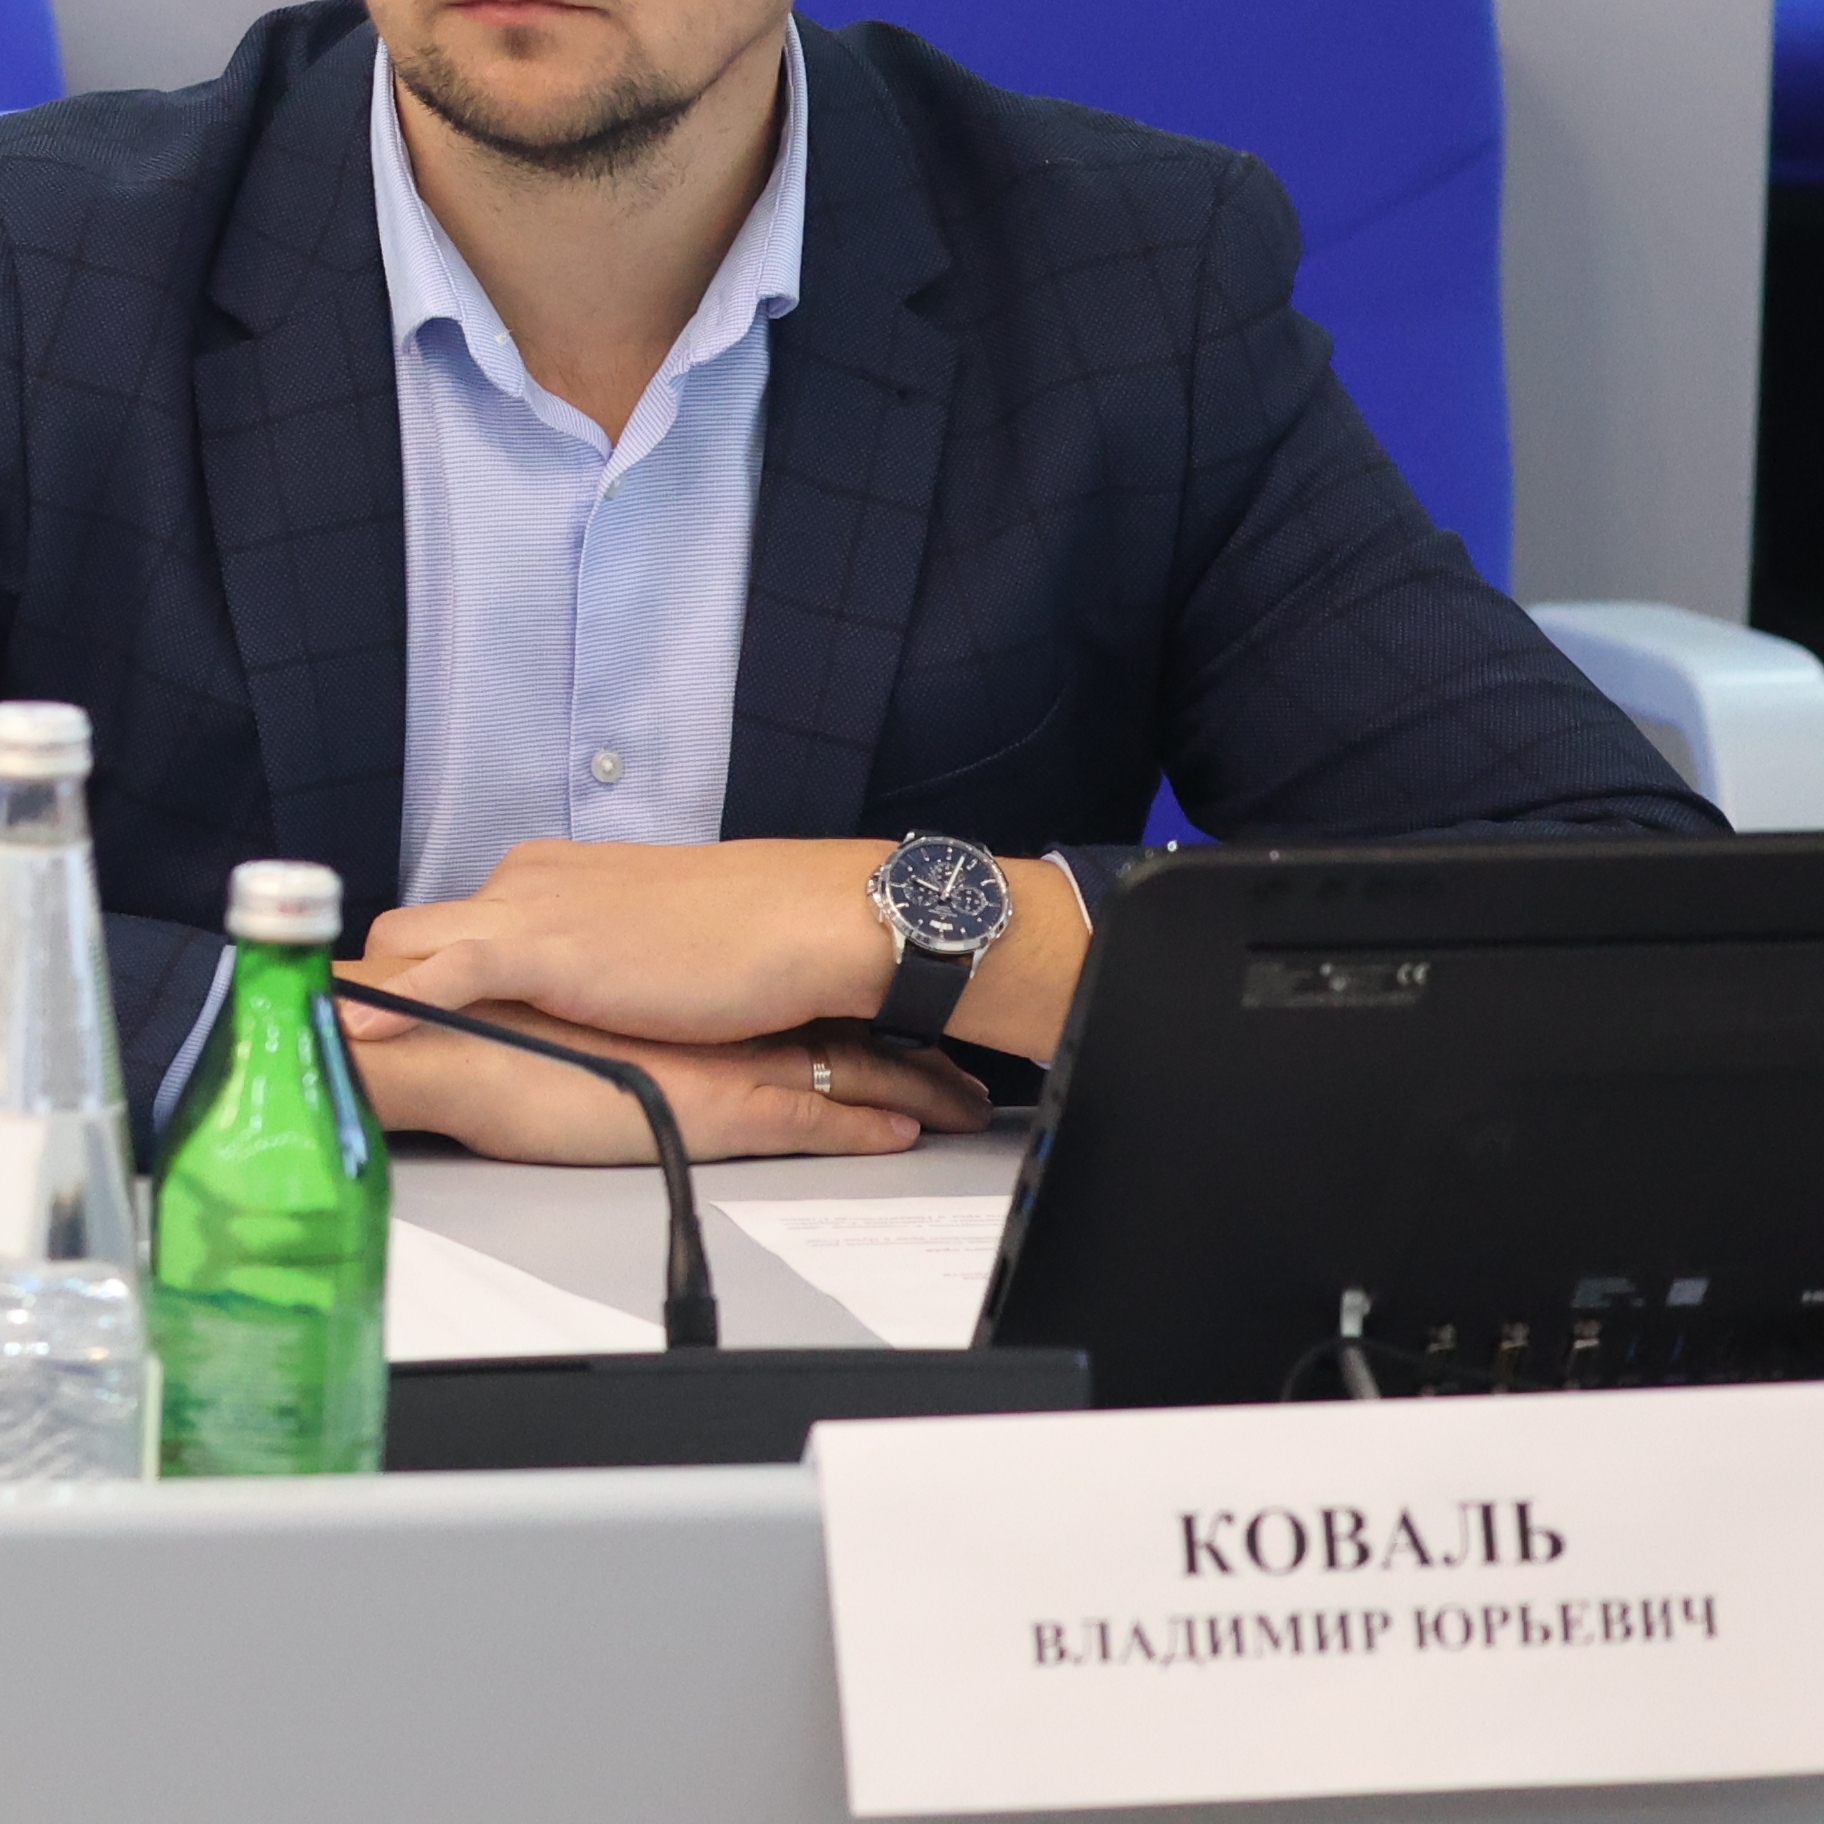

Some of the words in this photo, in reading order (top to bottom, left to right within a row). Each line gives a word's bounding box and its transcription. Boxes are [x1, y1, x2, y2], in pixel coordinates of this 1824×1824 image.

[1176, 1497, 1568, 1579] КОВАЛЬ
[1031, 1608, 1394, 1667] ВЛАДИМИР
[1412, 1593, 1719, 1652] ЮРЬЕВИЧ
